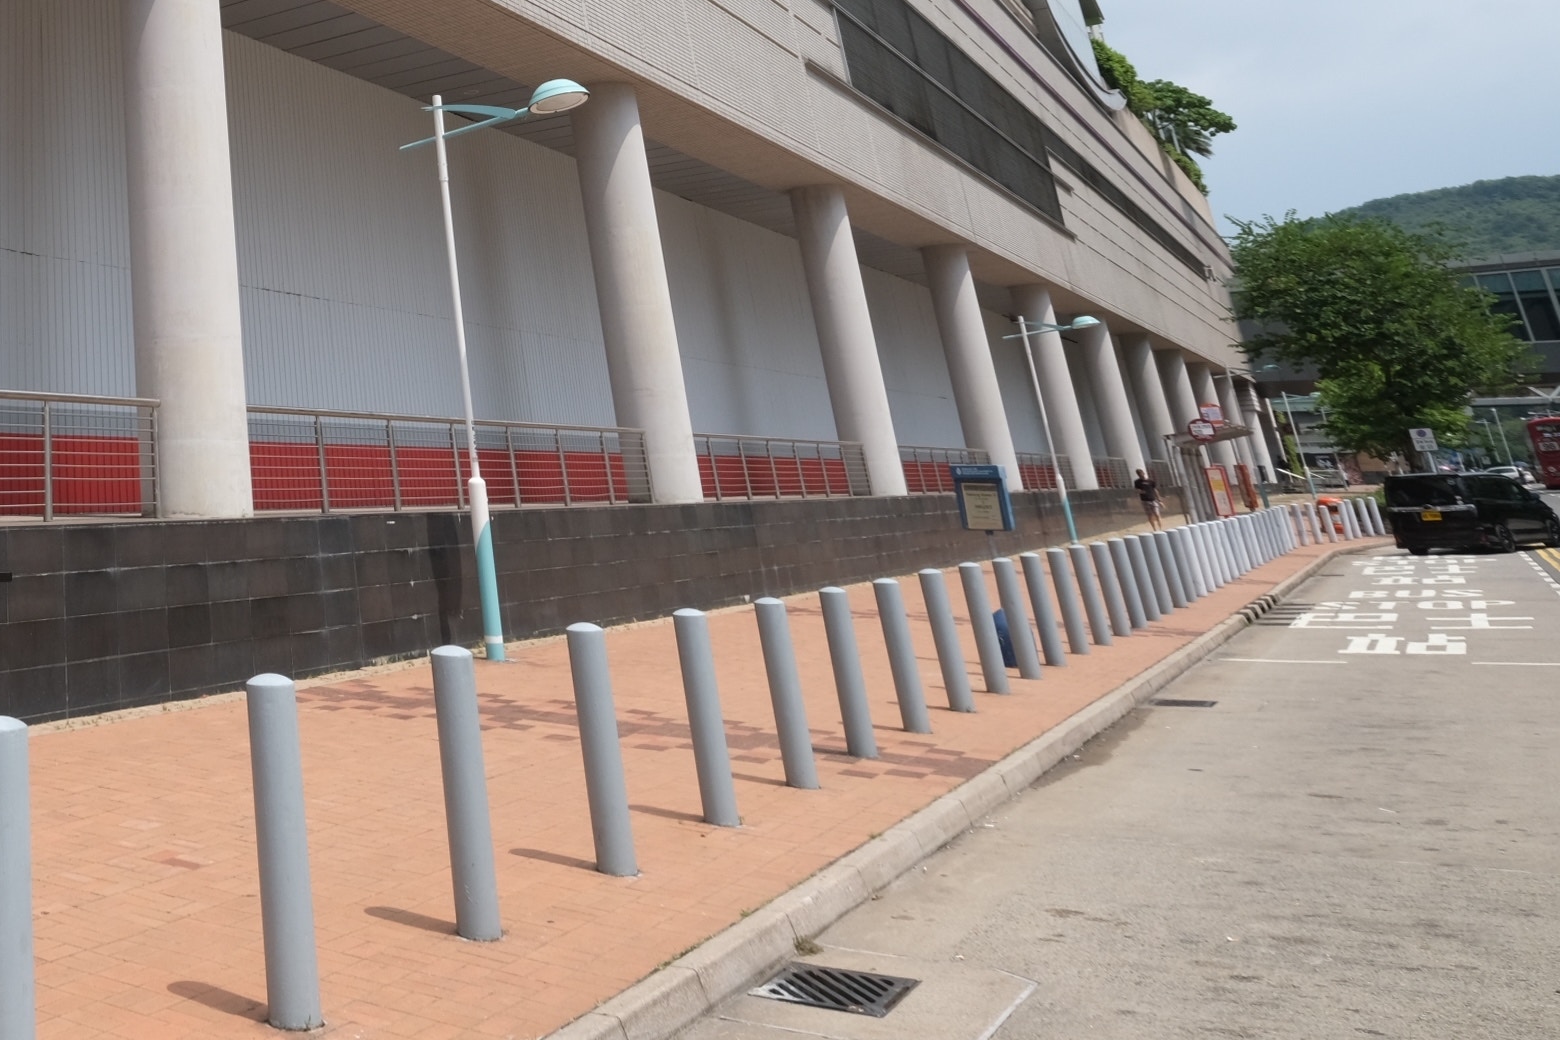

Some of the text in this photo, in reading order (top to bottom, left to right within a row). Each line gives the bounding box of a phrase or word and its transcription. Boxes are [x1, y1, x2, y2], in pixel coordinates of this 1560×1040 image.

[1352, 558, 1497, 566] STOP
[1362, 564, 1478, 575] 巴士
[1371, 575, 1467, 585] 站
[1348, 589, 1484, 599] BUS
[1314, 600, 1516, 610] STOP
[1288, 613, 1535, 630] 巴士
[1337, 633, 1467, 655] 站
